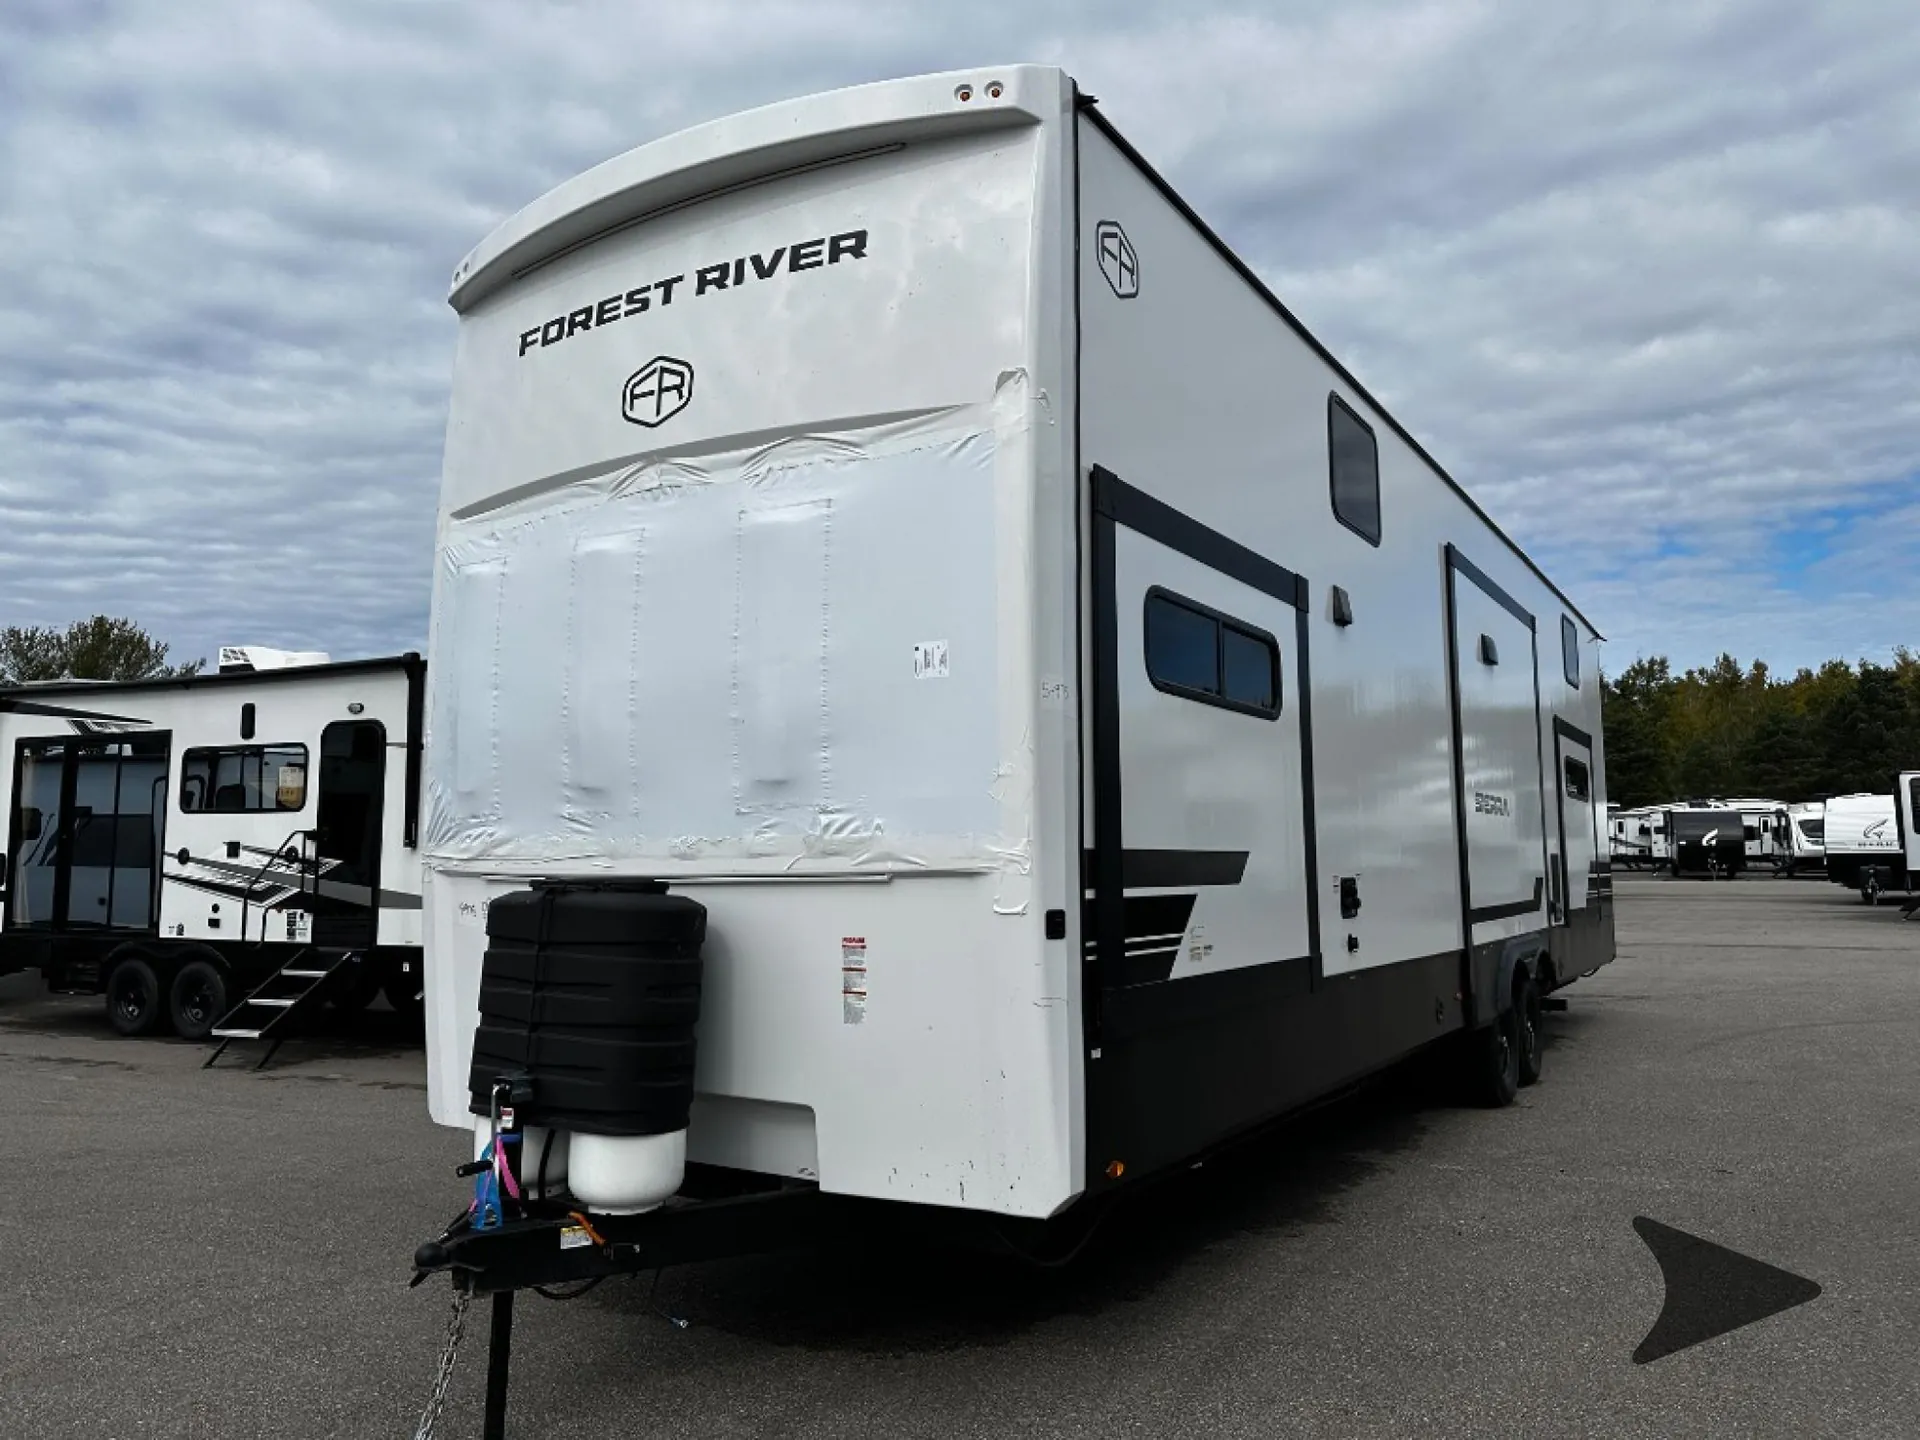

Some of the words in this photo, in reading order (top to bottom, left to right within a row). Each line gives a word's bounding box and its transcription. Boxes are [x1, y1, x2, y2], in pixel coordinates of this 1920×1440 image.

[518, 274, 685, 357] FOREST
[695, 229, 868, 296] RIVER
[629, 365, 687, 417] FR
